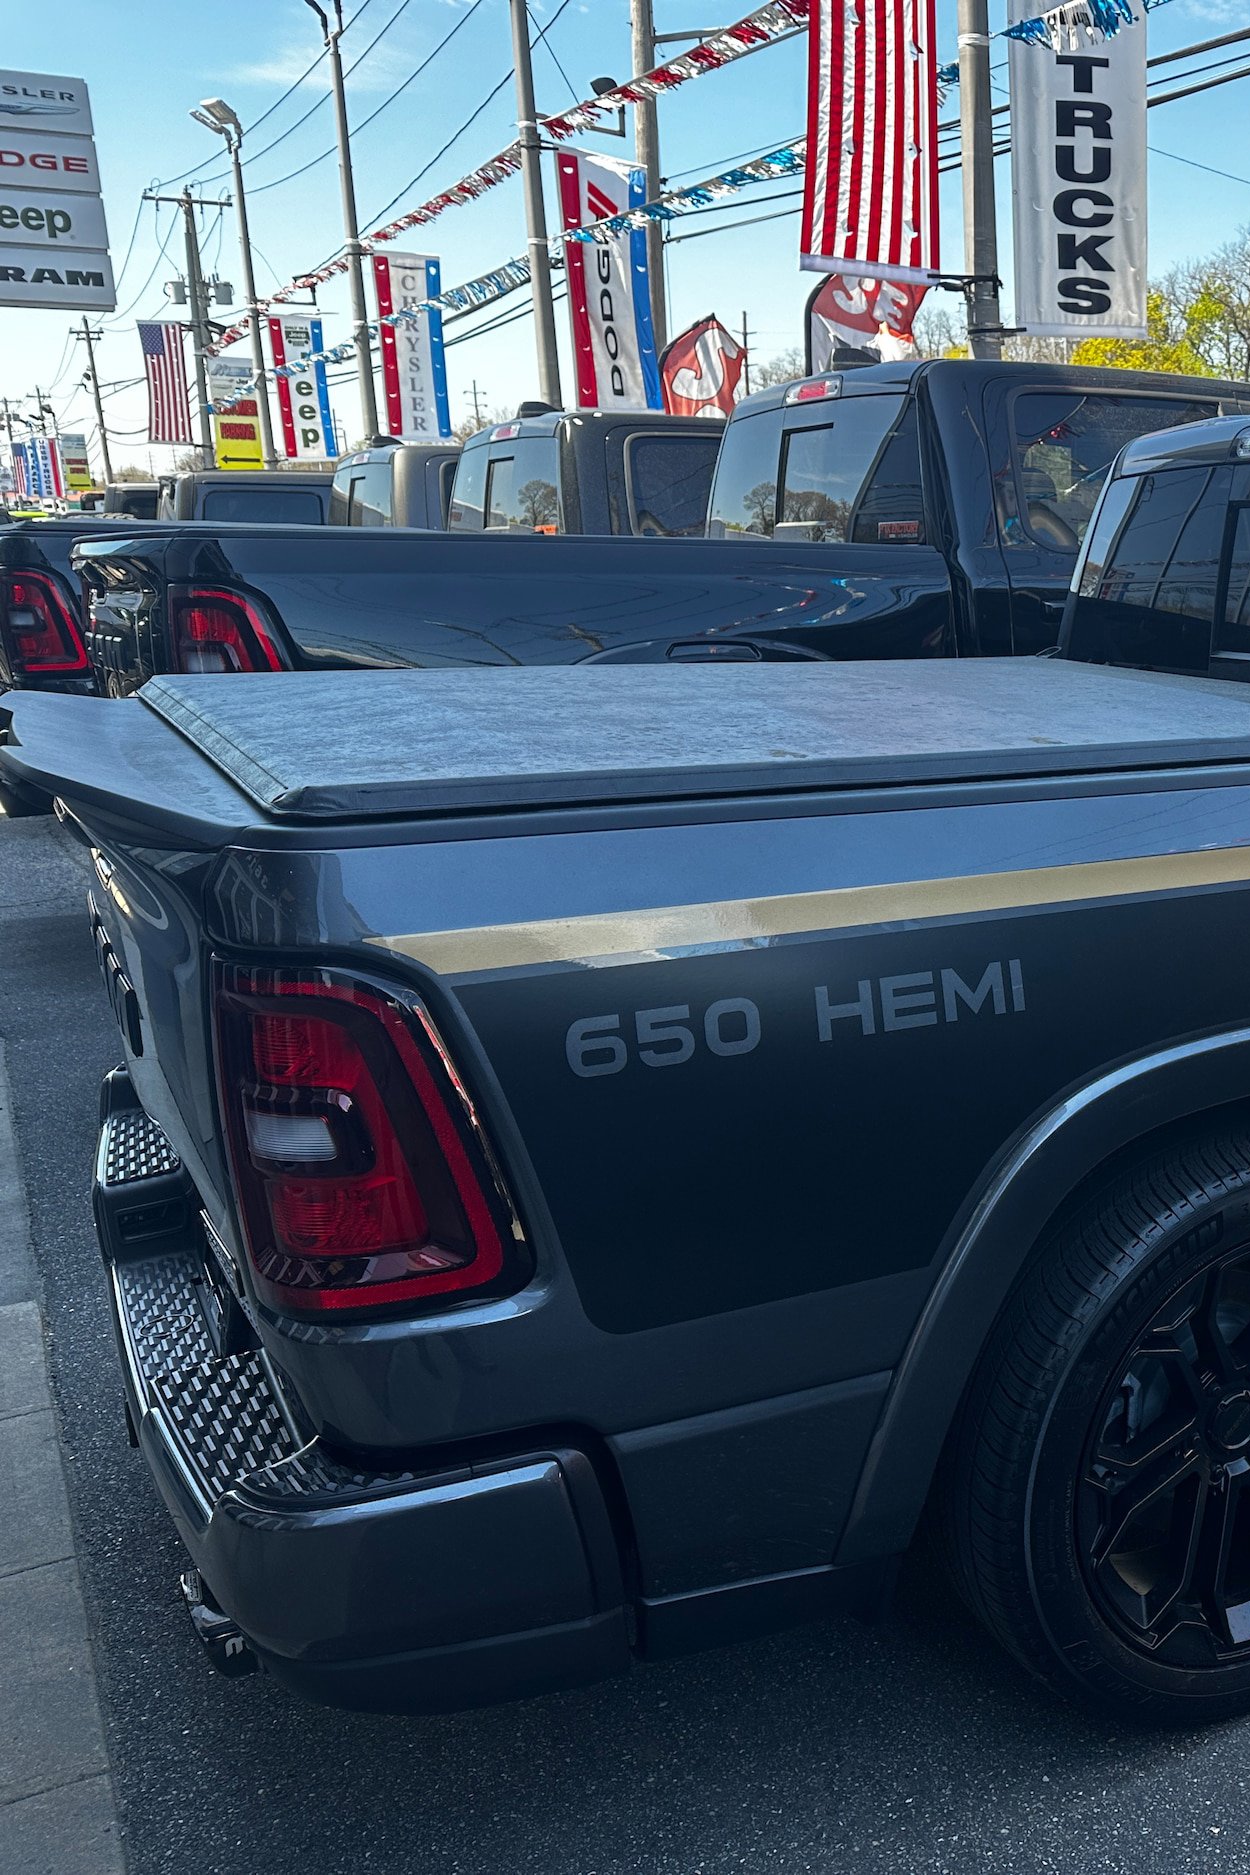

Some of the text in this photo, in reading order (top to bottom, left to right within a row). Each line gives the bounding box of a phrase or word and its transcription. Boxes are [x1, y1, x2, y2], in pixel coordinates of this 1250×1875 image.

[1053, 55, 1116, 315] TRUCKS
[0, 266, 105, 287] RAM
[596, 214, 625, 396] DODG
[565, 958, 1027, 1078] 650 HEMI
